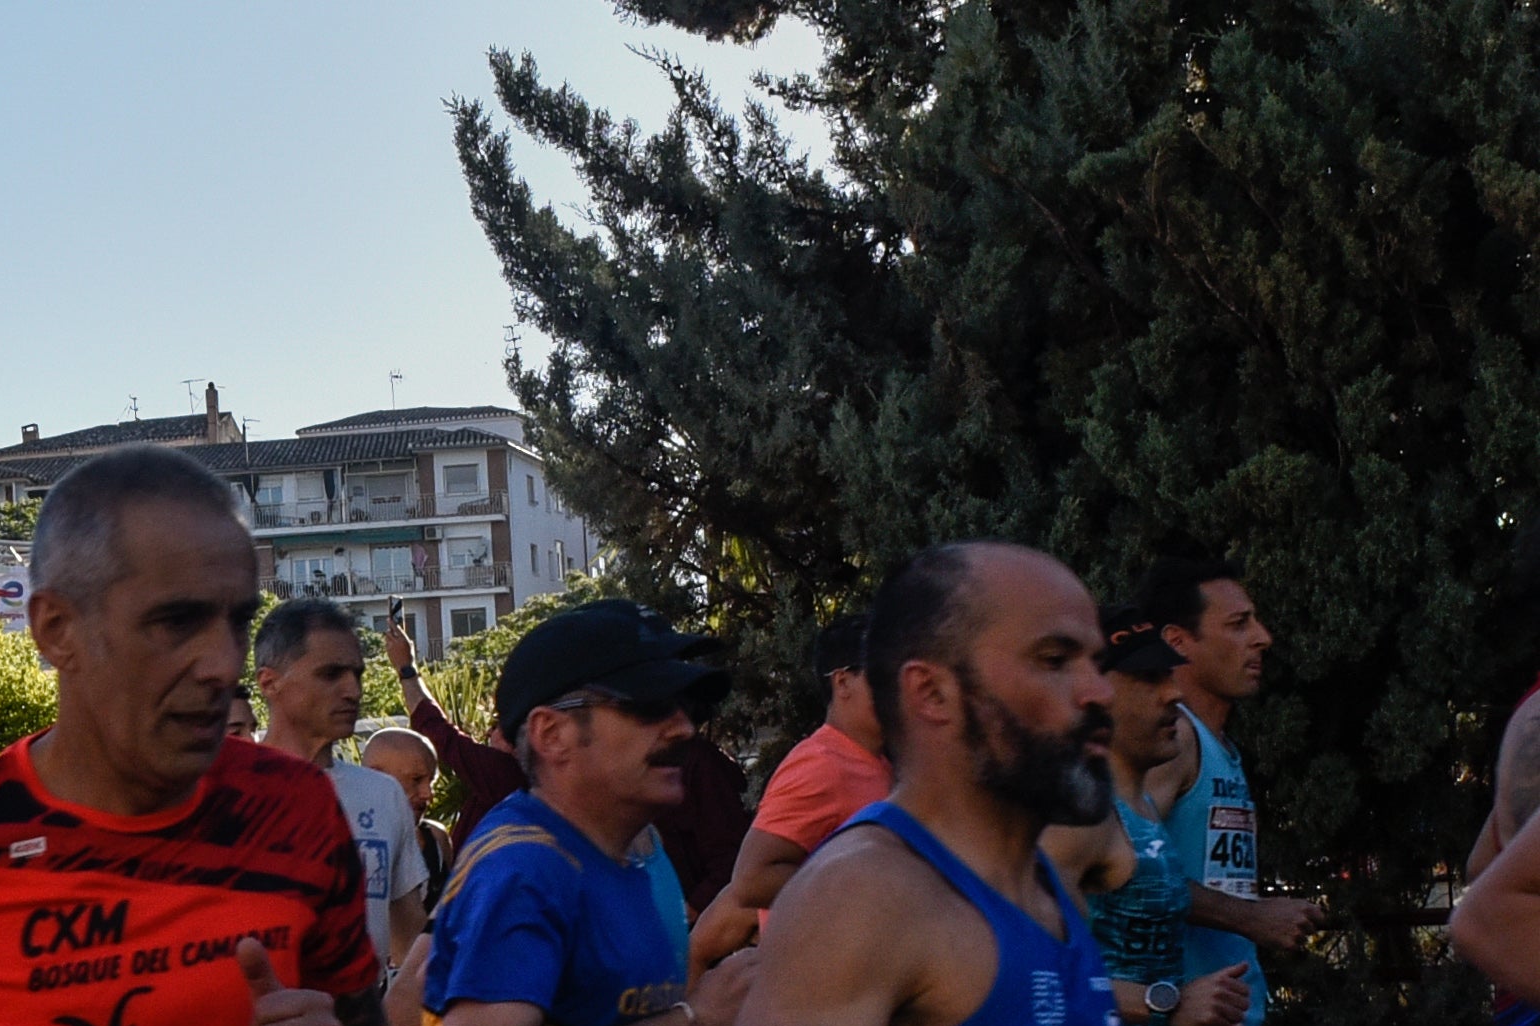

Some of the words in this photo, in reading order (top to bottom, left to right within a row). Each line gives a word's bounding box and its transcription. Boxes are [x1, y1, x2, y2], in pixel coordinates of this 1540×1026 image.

[21, 899, 129, 958] CXM
[27, 954, 123, 993] BOSQUE
[131, 948, 171, 976] DEL
